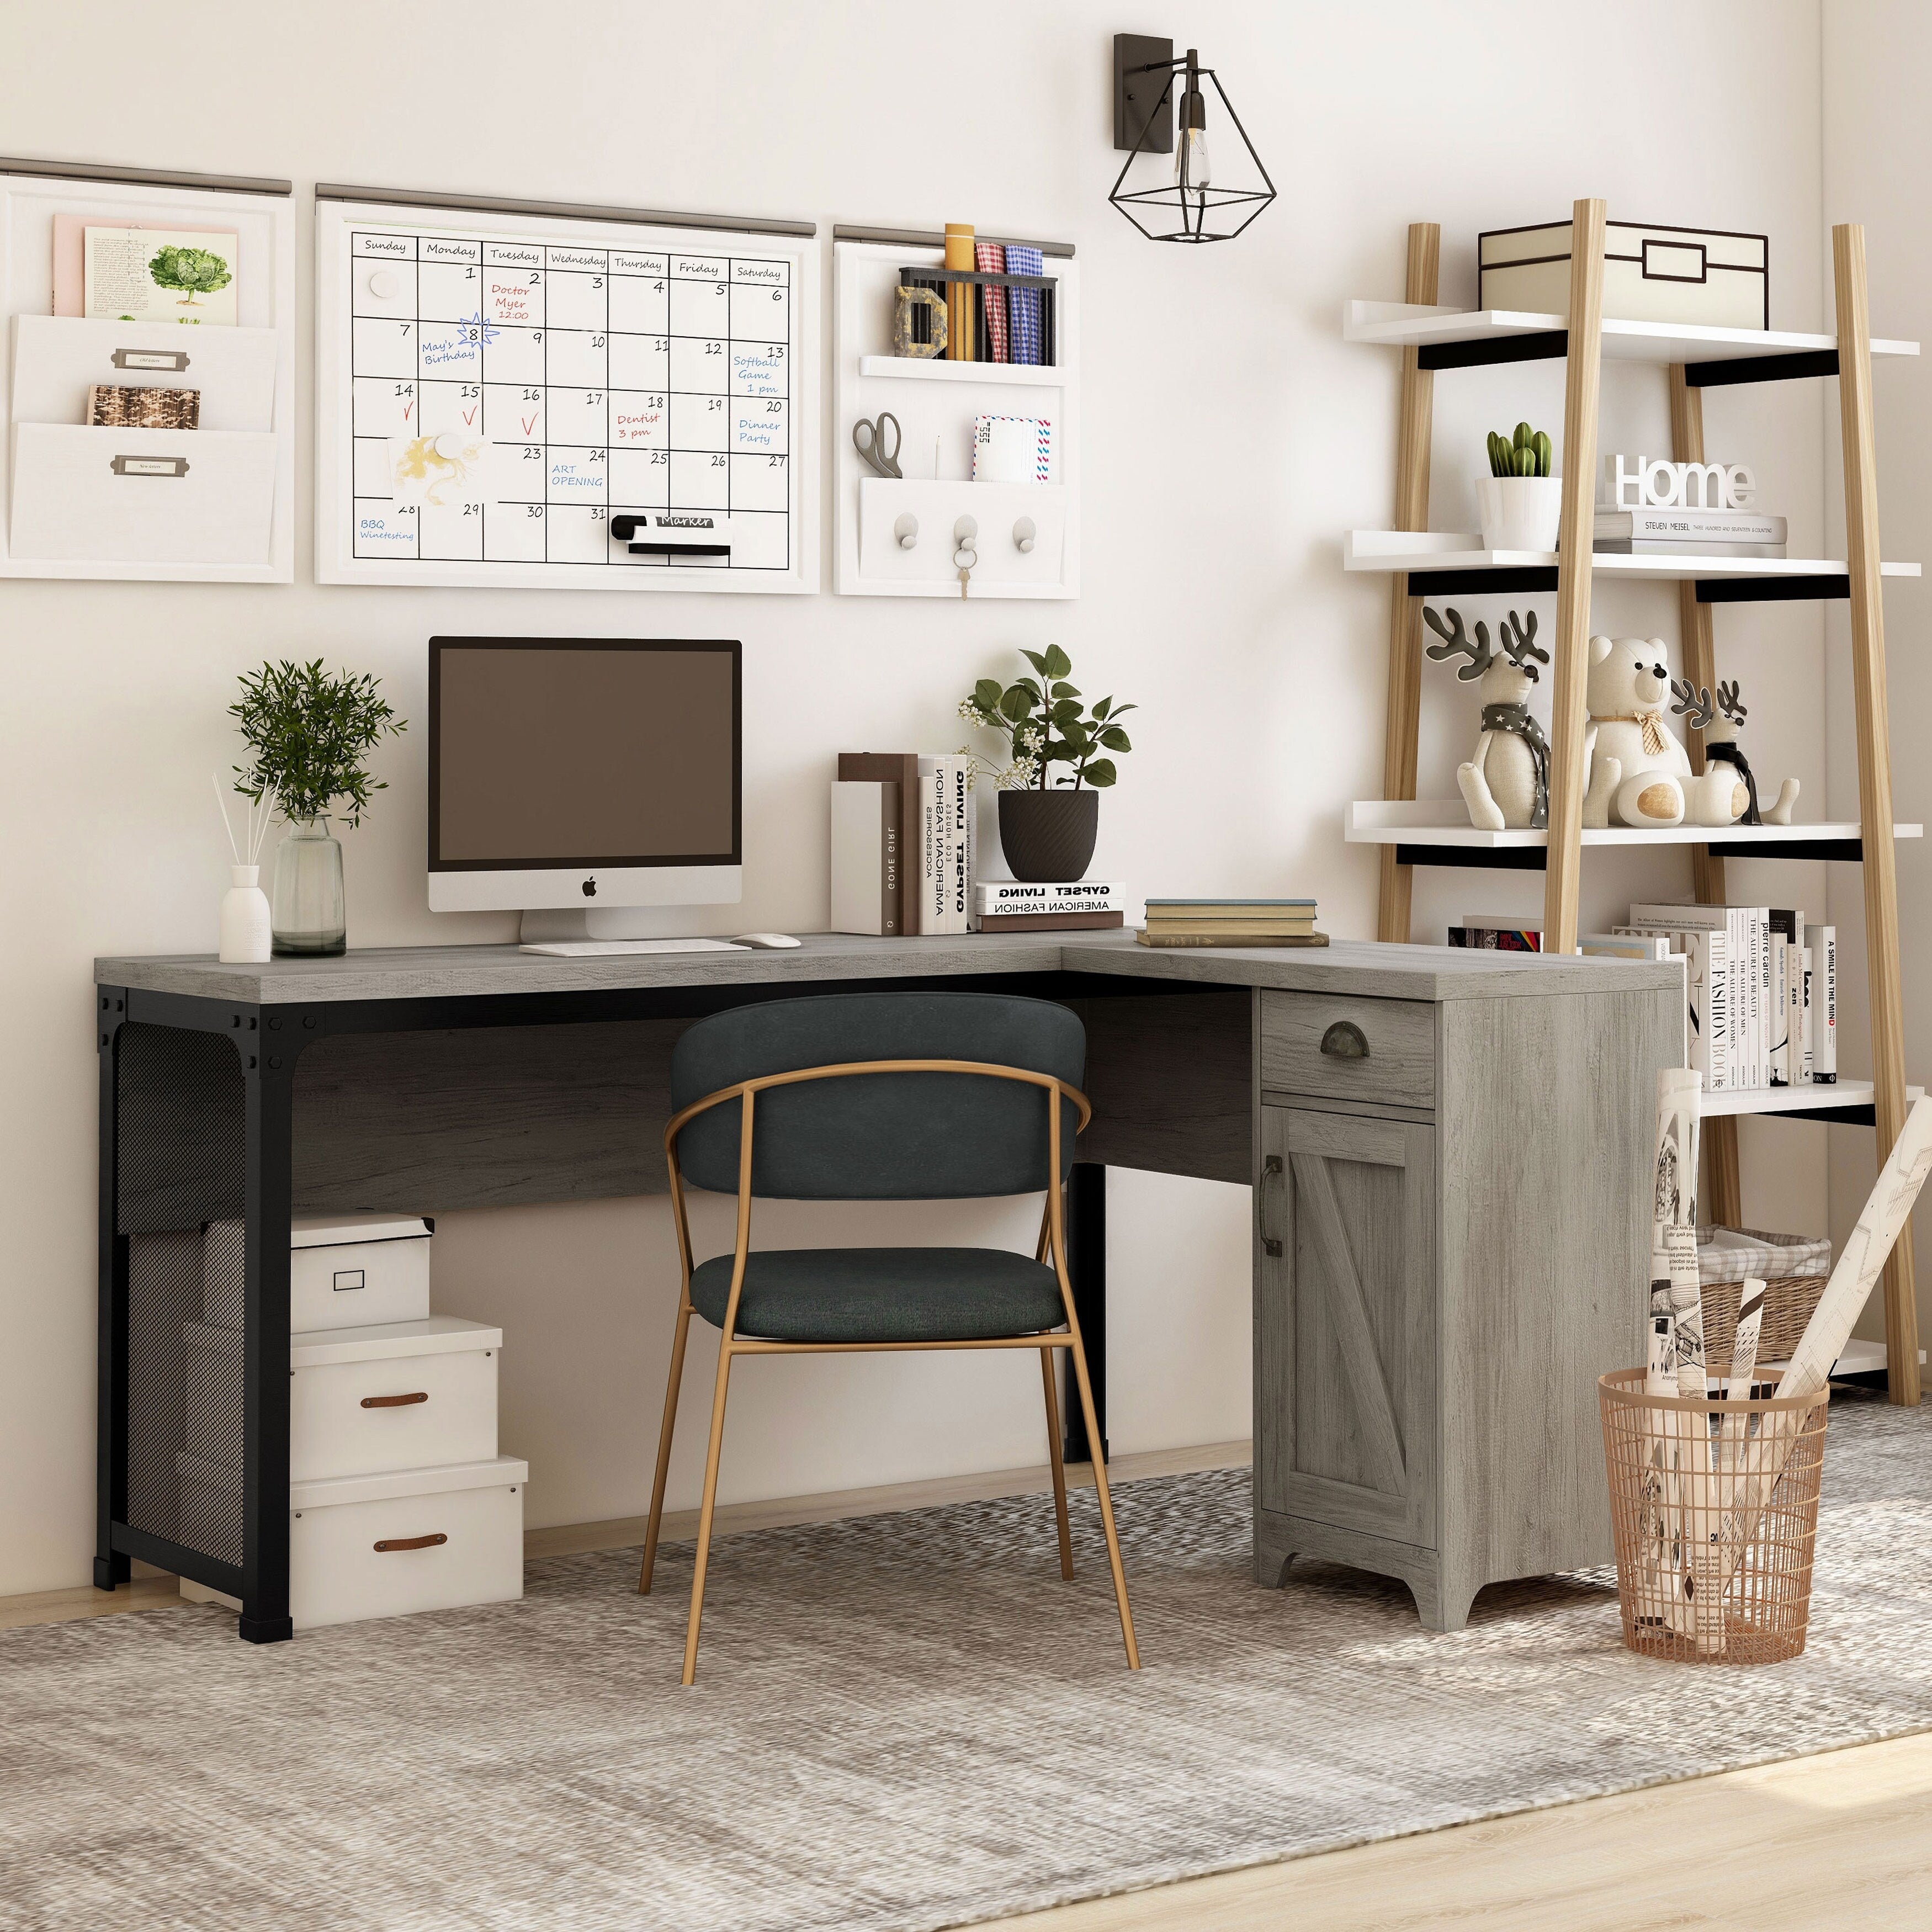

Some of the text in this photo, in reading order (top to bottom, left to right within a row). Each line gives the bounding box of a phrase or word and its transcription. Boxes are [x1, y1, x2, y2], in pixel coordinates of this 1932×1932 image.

[365, 240, 781, 280] Sunday Monday Tuesday Wednesday Thursday Friday Saturday
[465, 267, 476, 279] 1
[529, 273, 541, 285] 2
[592, 277, 603, 289] 3
[653, 282, 665, 293] 4
[492, 284, 530, 296] Doctor
[715, 284, 727, 295] 5
[772, 290, 782, 301] 6
[495, 298, 526, 310] Myer
[498, 311, 529, 320] 12:00
[400, 324, 411, 336] 7
[469, 329, 478, 341] 8
[533, 332, 543, 344] 9
[592, 336, 605, 348] 10
[422, 339, 454, 353] May's
[655, 339, 670, 352] 11
[705, 343, 723, 354] 12
[425, 350, 475, 365] Birthday
[767, 347, 784, 358] 13
[734, 356, 781, 368] Softball
[738, 369, 772, 381] Game
[395, 384, 414, 396] 14
[461, 385, 480, 397] 15
[522, 389, 540, 401] 16
[747, 384, 778, 395] 1 pm
[586, 394, 603, 405] 17
[648, 396, 664, 408] 18
[708, 399, 723, 411] 19
[767, 401, 782, 413] 20
[617, 413, 661, 424] Dentist
[739, 420, 781, 431] Dinner
[618, 428, 651, 440] 3 pm
[739, 433, 771, 445] Party
[523, 448, 542, 460] 23
[589, 450, 606, 463] 24
[651, 453, 668, 465] 25
[711, 456, 726, 467] 26
[769, 456, 786, 468] 27
[552, 464, 576, 474] ART
[551, 476, 603, 487] OPENING
[1615, 454, 1756, 509] Home
[463, 503, 480, 516] 29
[527, 506, 544, 518] 30
[591, 508, 606, 520] 31
[360, 519, 385, 529] BBQ
[661, 516, 710, 527] Marker
[1645, 522, 1667, 530] STEVEN
[1670, 523, 1690, 531] MEISEL
[360, 530, 415, 542] Winetesting
[1761, 922, 1770, 953] pierre
[1712, 933, 1726, 967] THE
[1750, 972, 1757, 984] OF
[1828, 976, 1835, 984] IN
[1711, 971, 1727, 1039] FASHION
[1730, 1008, 1735, 1018] OF
[1740, 1007, 1746, 1018] OF
